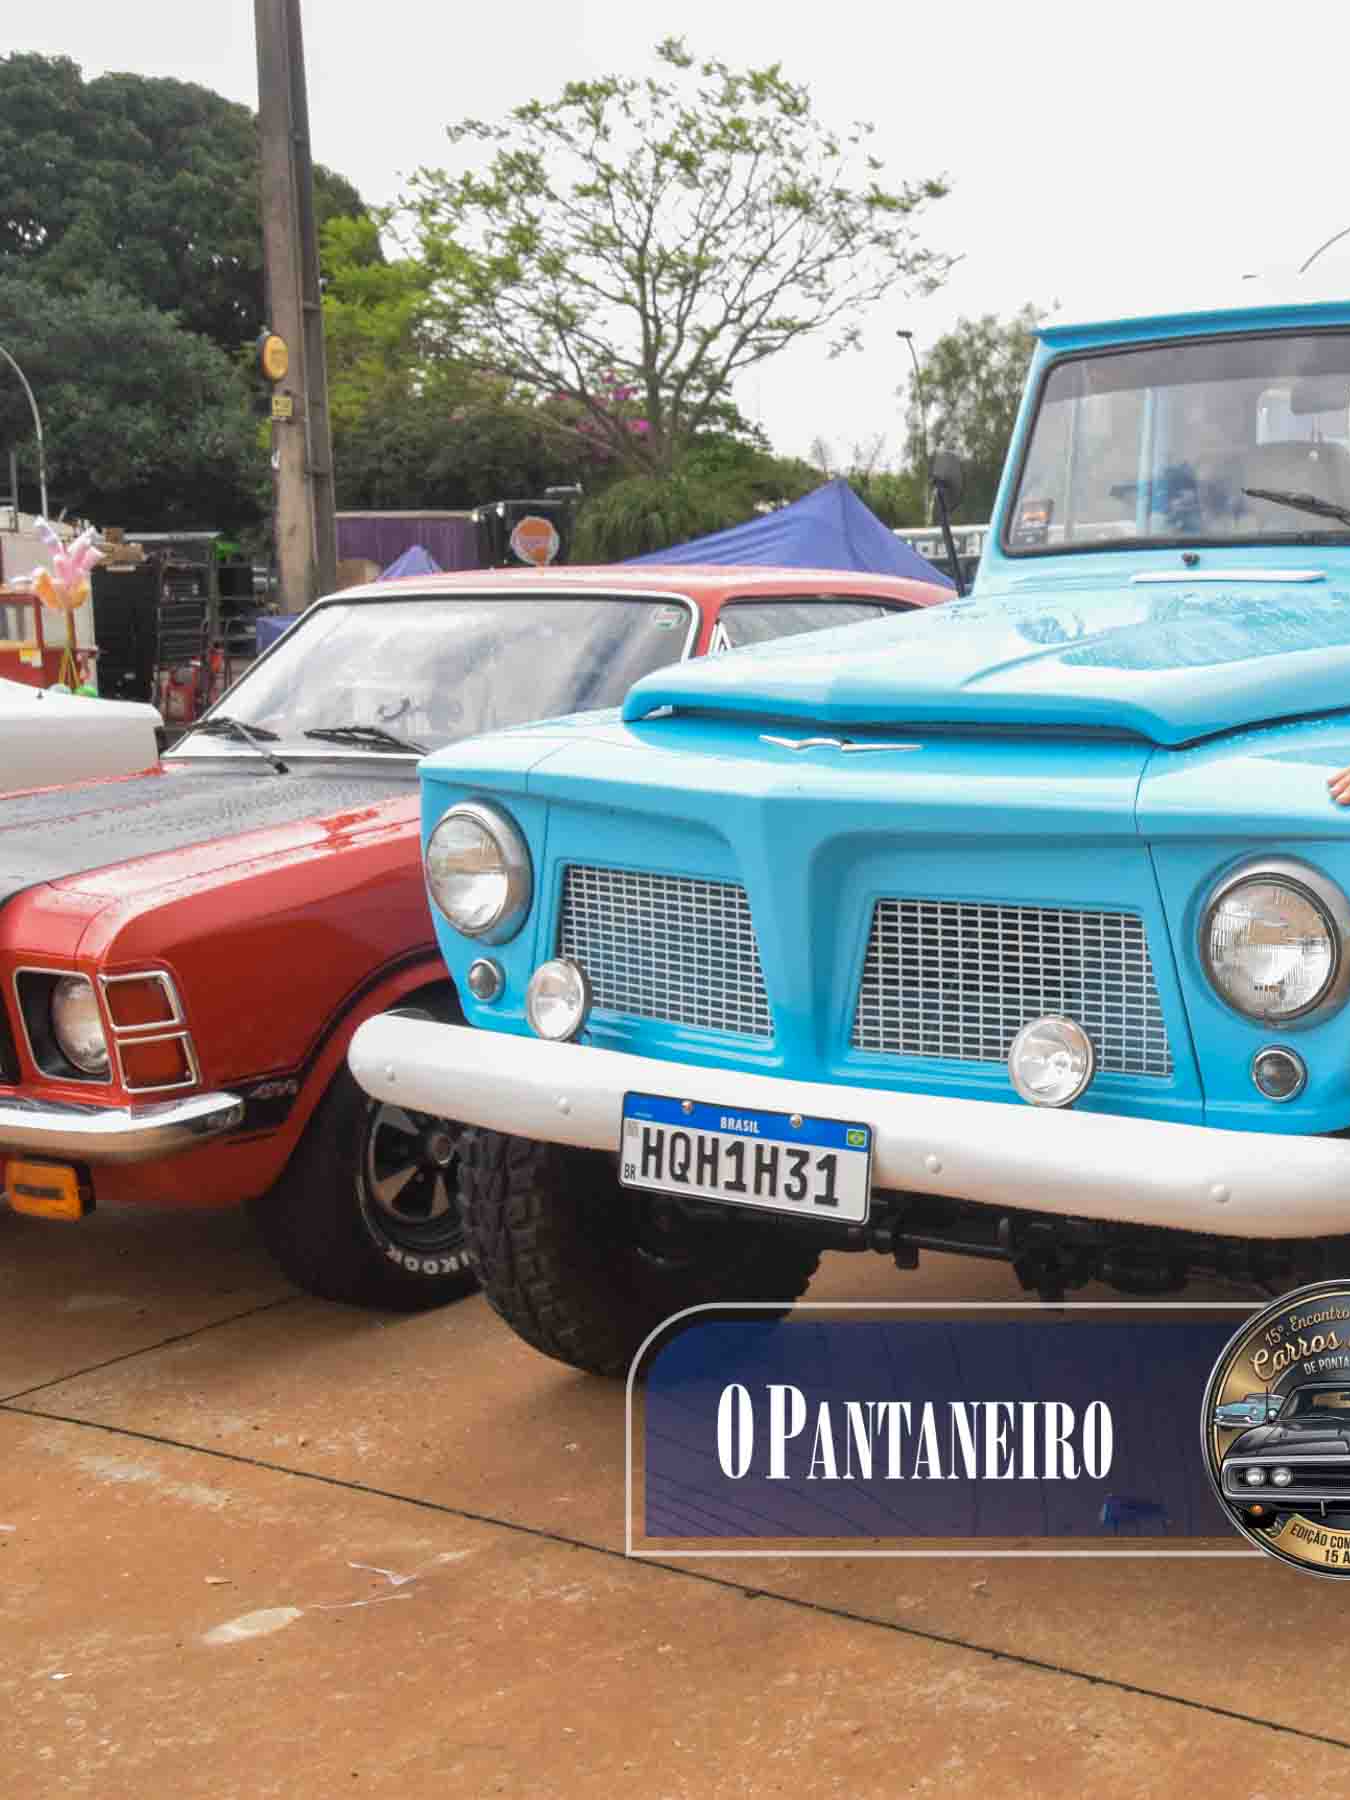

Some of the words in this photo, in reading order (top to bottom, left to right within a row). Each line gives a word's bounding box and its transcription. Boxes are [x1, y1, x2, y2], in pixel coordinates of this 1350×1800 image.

[720, 1115, 761, 1134] BRASIL
[624, 1162, 637, 1181] BR
[640, 1126, 840, 1208] HQH1H31
